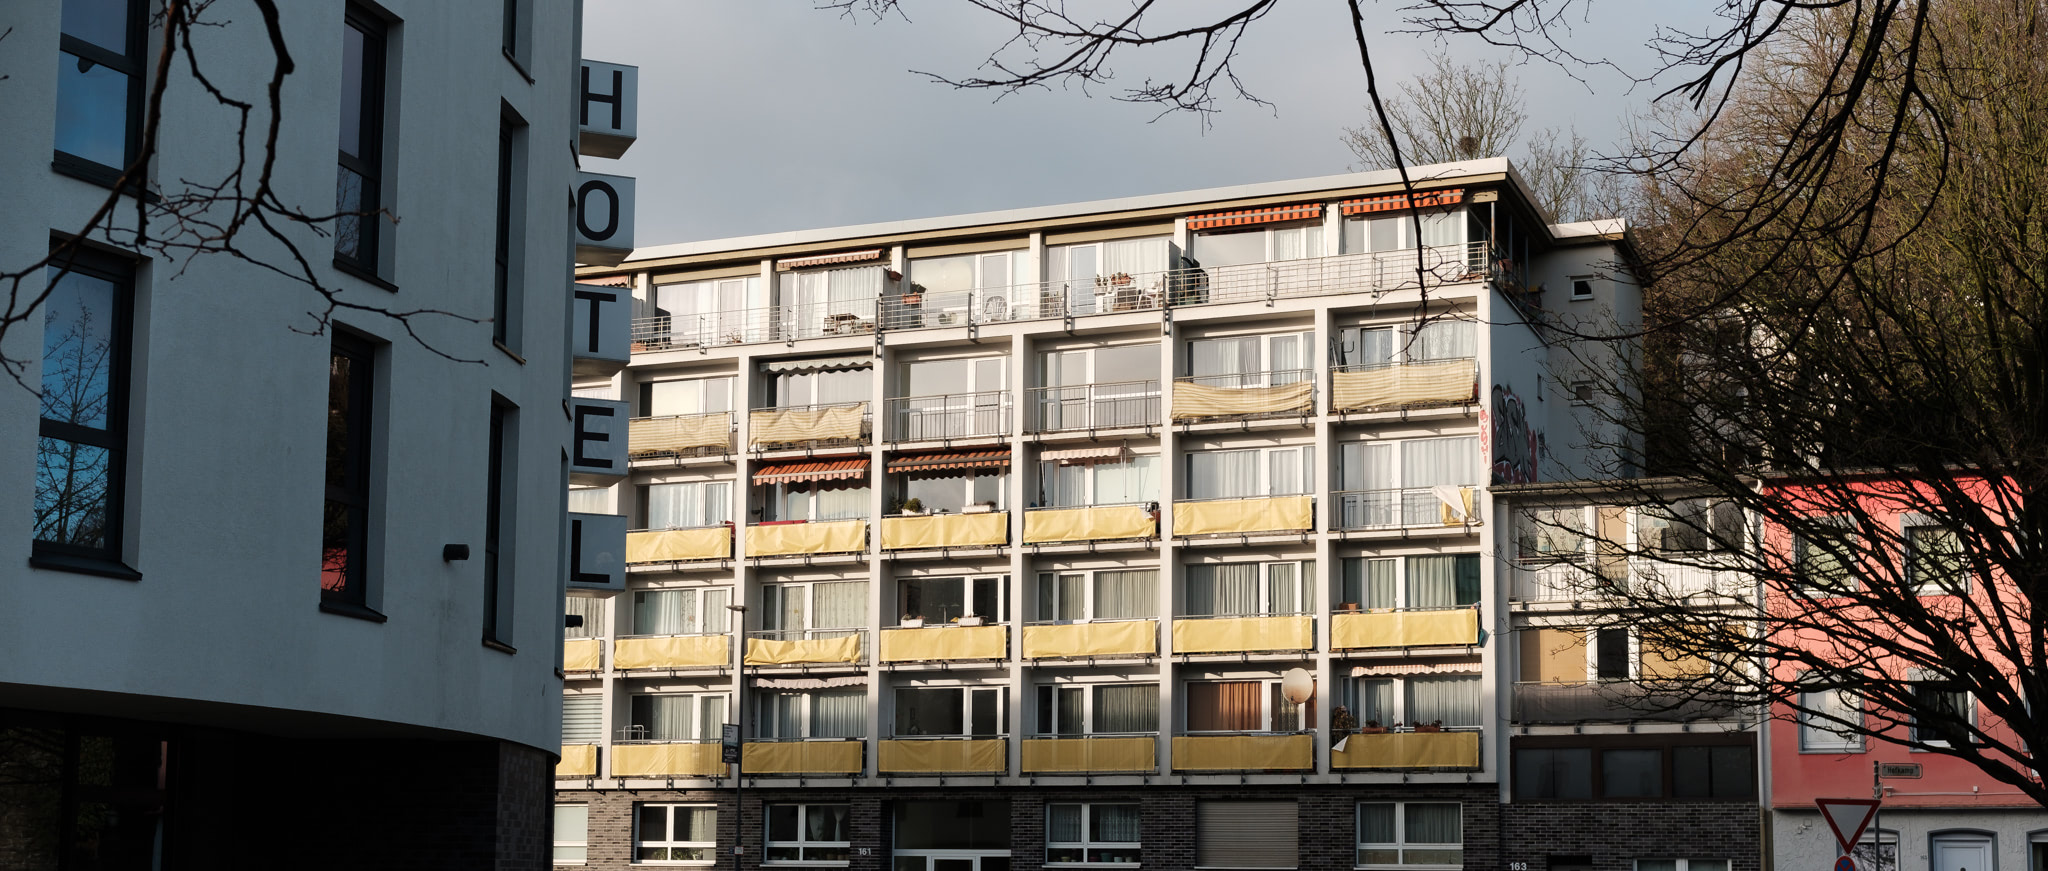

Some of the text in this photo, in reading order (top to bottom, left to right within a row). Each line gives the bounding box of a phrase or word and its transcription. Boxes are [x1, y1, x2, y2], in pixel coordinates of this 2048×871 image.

[570, 65, 623, 584] HOTEL
[858, 847, 871, 856] 161
[1510, 862, 1527, 871] 163
